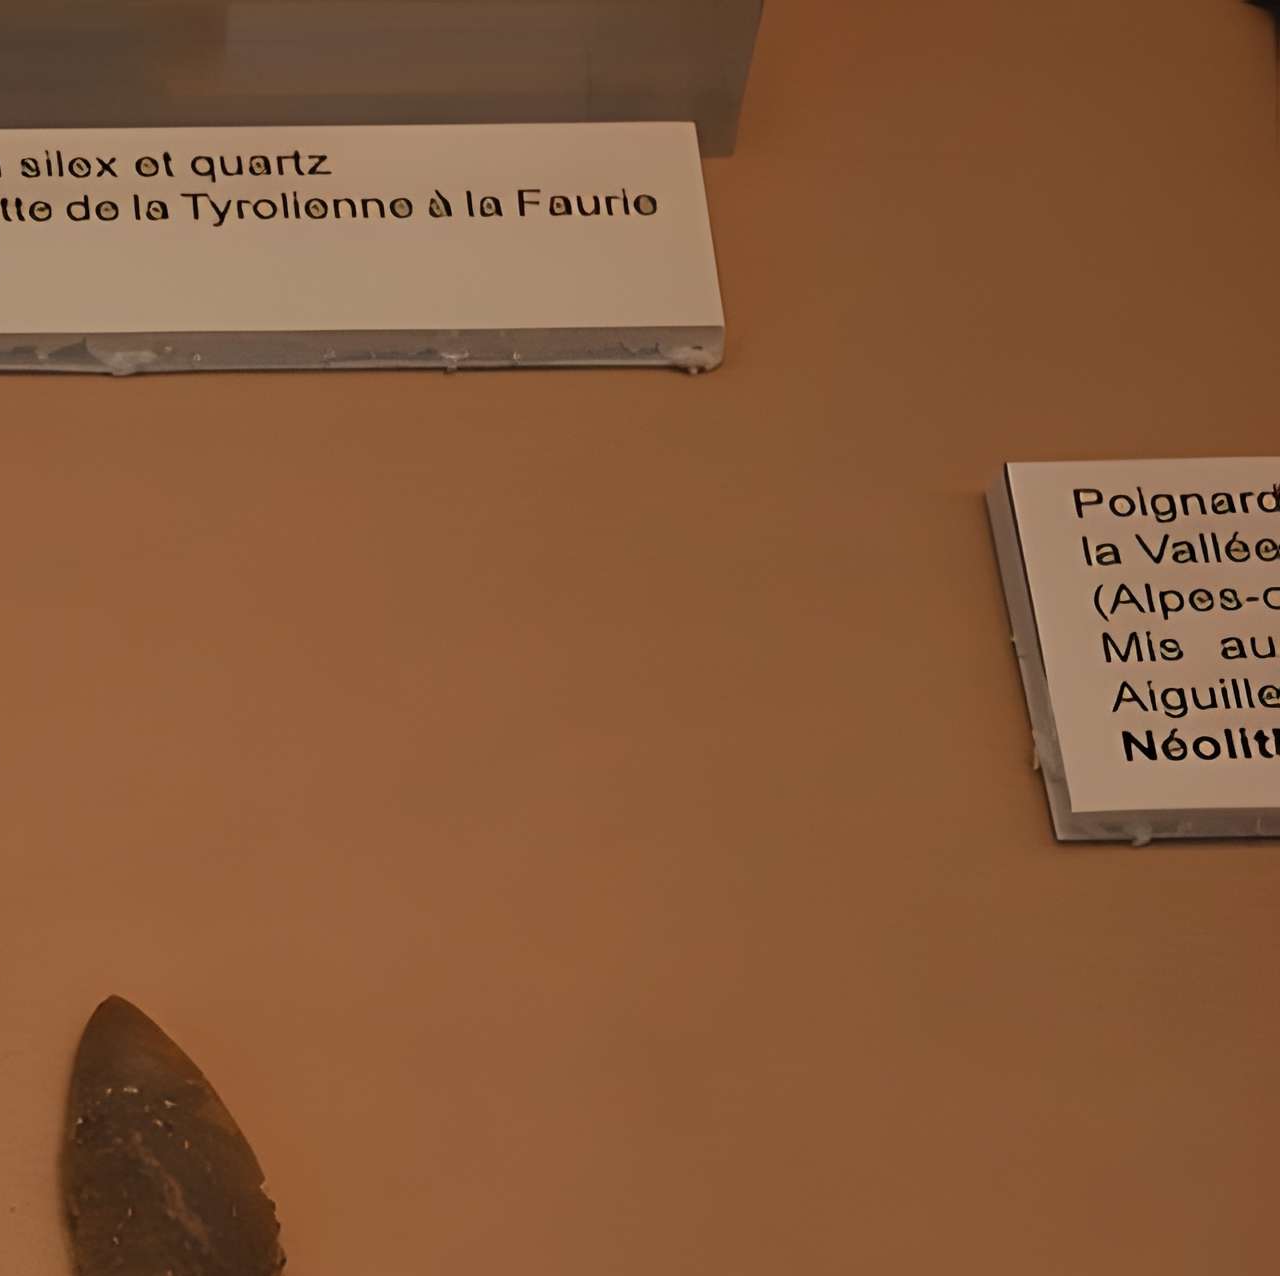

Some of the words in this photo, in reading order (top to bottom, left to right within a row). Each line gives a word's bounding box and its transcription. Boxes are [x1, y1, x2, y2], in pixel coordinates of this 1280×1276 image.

[20, 150, 118, 179] silex
[134, 151, 174, 178] et
[190, 150, 332, 184] quartz
[66, 194, 119, 222] de
[133, 193, 169, 221] la
[180, 190, 413, 228] Tyrolienne
[428, 189, 453, 218] à
[465, 190, 504, 218] la
[517, 187, 658, 217] Faurie
[1081, 535, 1122, 567] la
[1101, 630, 1184, 663] Mis
[1220, 635, 1276, 660] au
